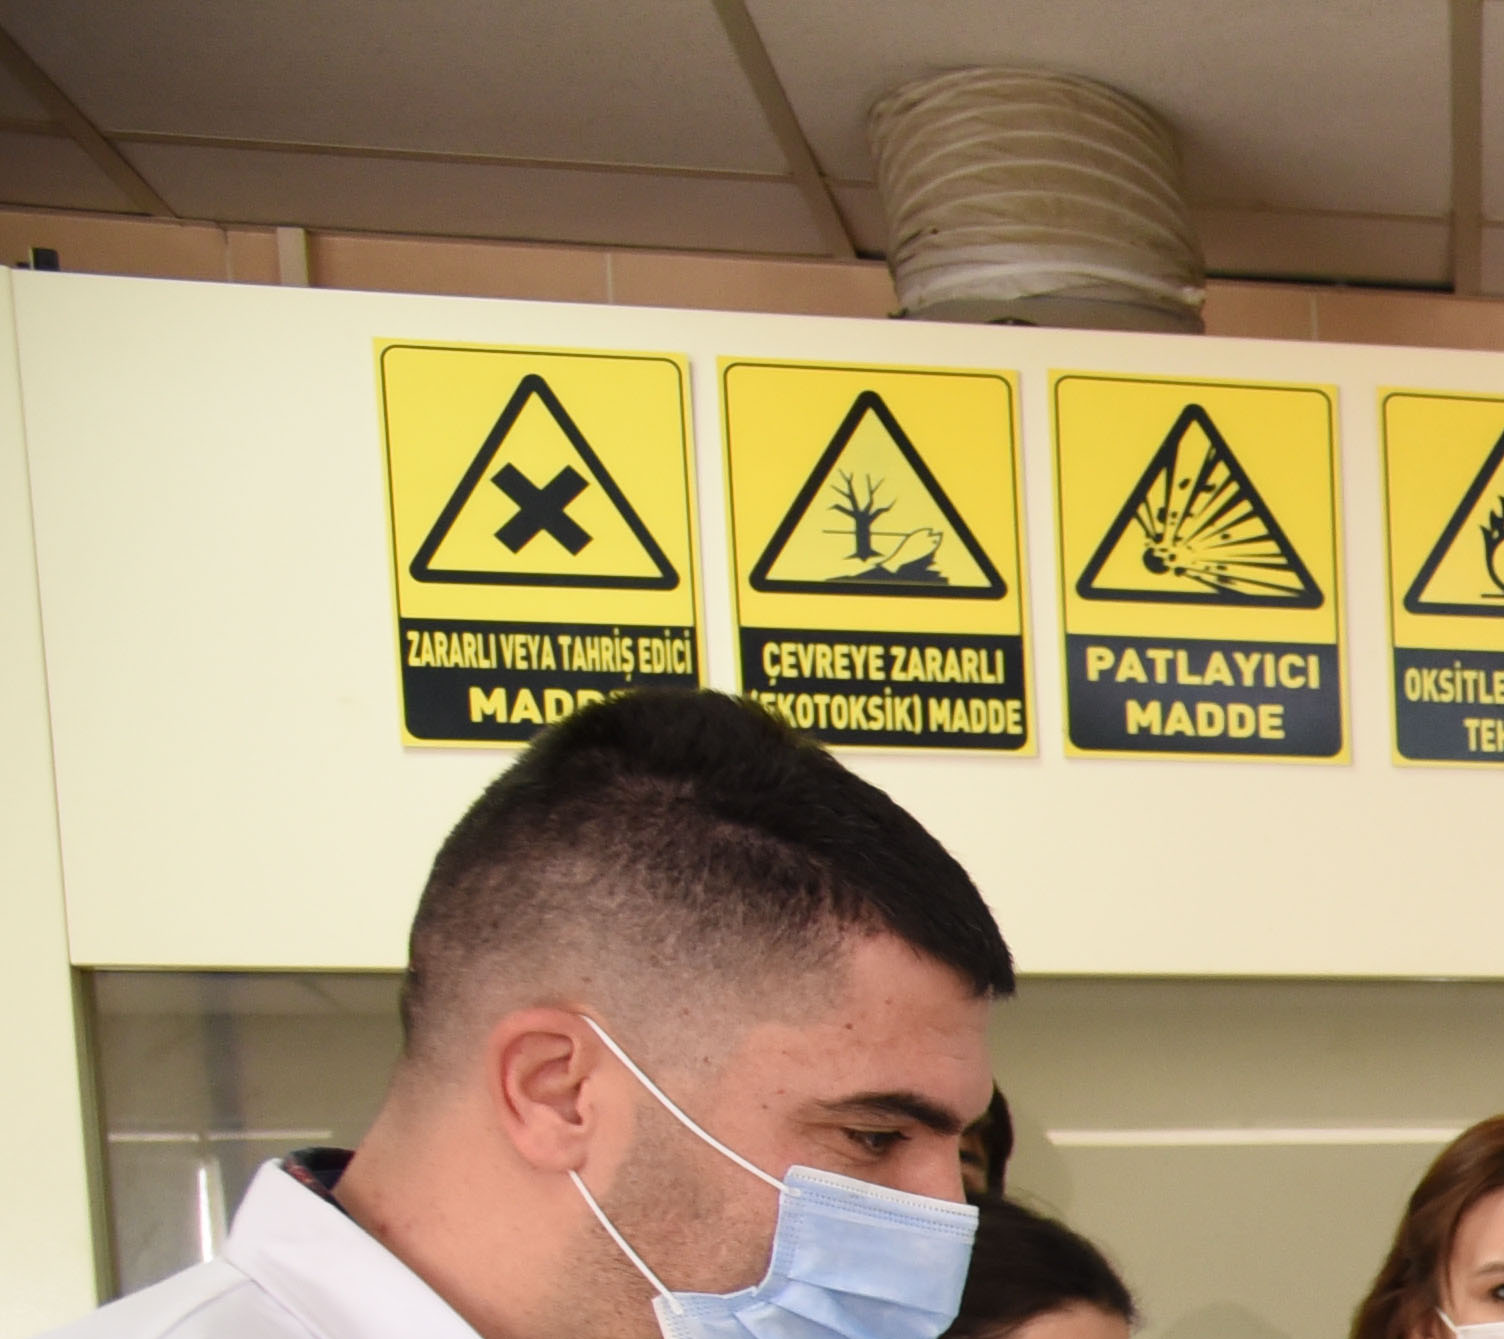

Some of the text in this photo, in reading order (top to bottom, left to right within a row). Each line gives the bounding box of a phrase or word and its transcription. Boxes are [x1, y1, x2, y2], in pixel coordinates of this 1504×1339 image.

[406, 627, 693, 682] ZARARLI VEYA TAHRİŞ EDİCİ
[762, 641, 1005, 687] ÇEVREYE ZARARLI
[1086, 646, 1320, 690] PATLAYICI
[468, 686, 628, 725] MAD
[751, 686, 1024, 735] KOTOKSİK) MADDE
[1125, 699, 1286, 740] MADDE
